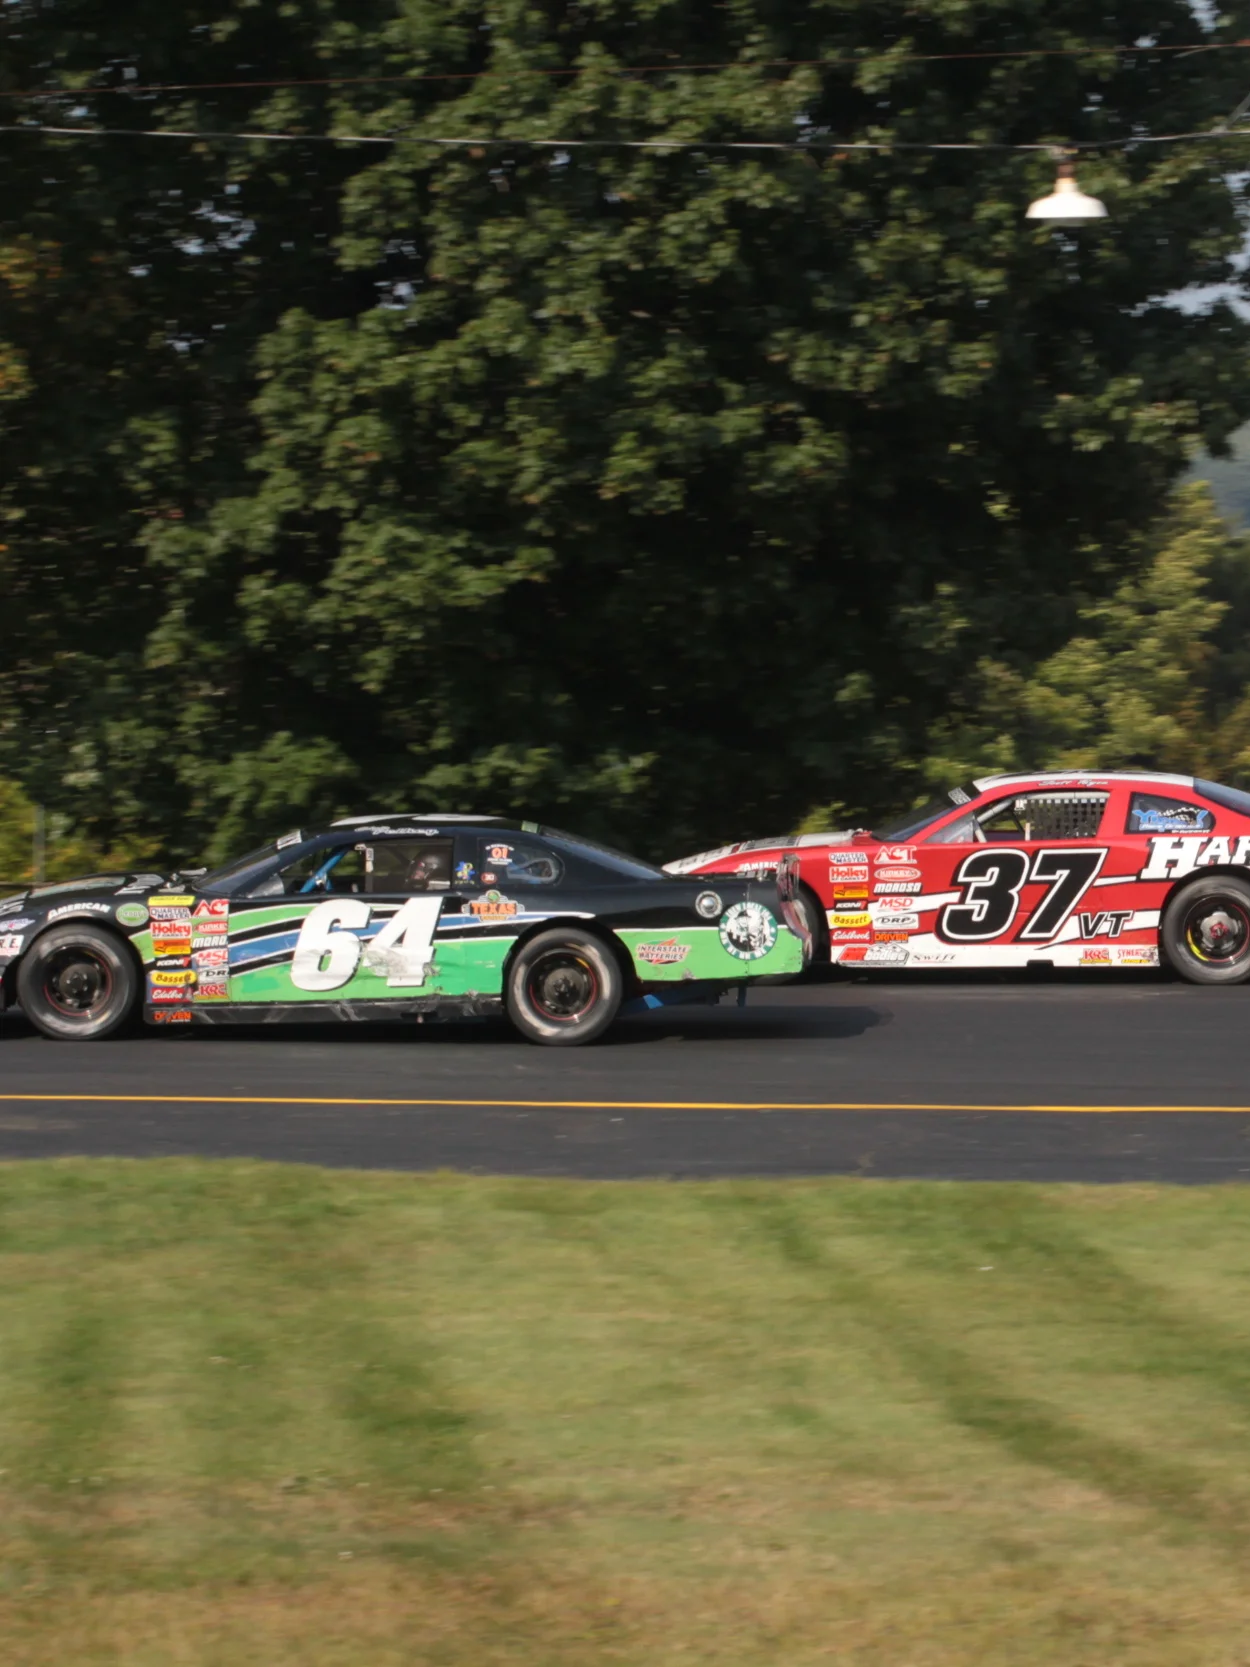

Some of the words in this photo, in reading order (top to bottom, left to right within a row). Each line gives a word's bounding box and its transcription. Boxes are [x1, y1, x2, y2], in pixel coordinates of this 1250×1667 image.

[874, 845, 918, 864] ACT
[831, 867, 867, 881] Holley
[873, 883, 922, 893] MOROSO
[938, 847, 1109, 942] 37
[470, 902, 516, 915] TEXAS
[880, 897, 914, 908] MSD
[47, 902, 111, 920] AMERICAN
[833, 915, 868, 924] Bassett
[881, 916, 910, 924] DRP
[1080, 909, 1135, 940] VT
[152, 922, 192, 937] Holley
[832, 930, 871, 940] Edelbrock
[192, 936, 229, 948] MORO
[874, 933, 909, 942] DRIVEN
[290, 896, 444, 992] 64
[637, 945, 688, 953] INTERSTATE
[638, 952, 684, 960] BATTERIES
[913, 953, 957, 961] Swift
[1083, 948, 1109, 960] KRC
[200, 984, 227, 996] KRC
